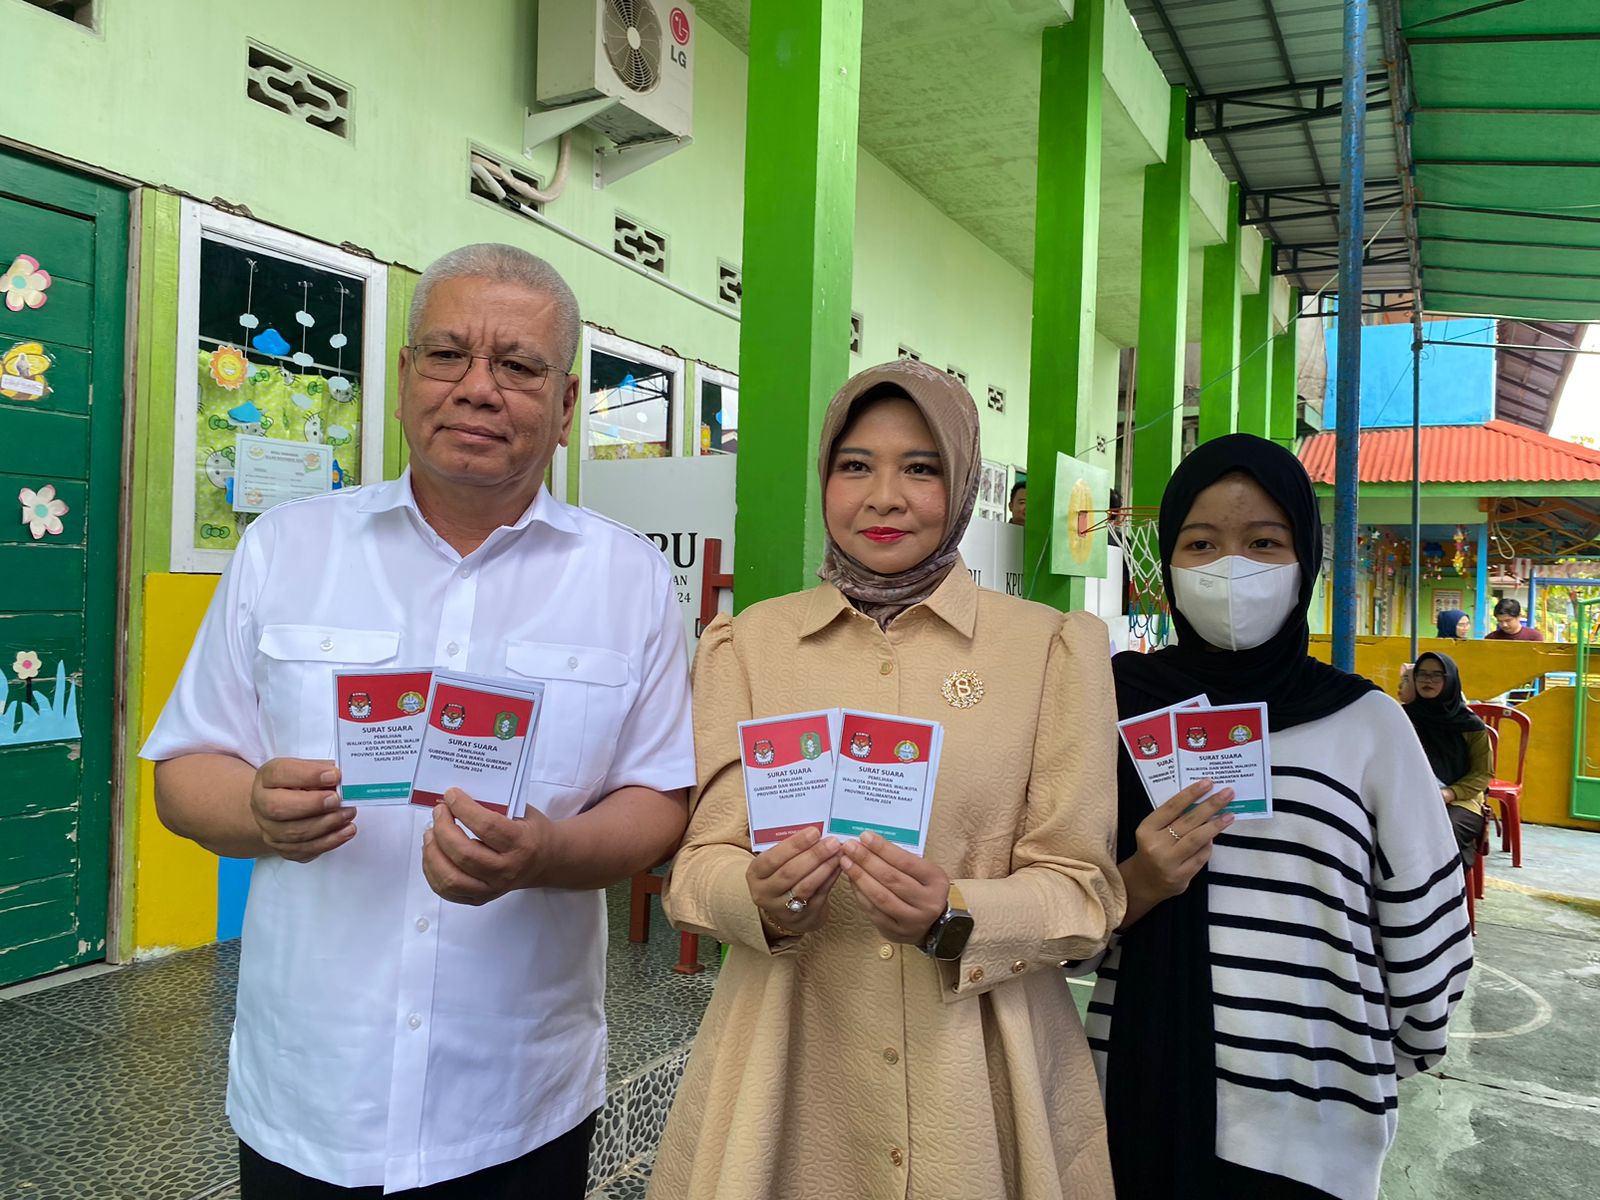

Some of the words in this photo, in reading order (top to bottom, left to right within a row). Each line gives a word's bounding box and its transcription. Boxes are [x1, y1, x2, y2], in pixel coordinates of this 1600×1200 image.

[671, 45, 687, 69] LG
[448, 738, 472, 748] SURAT
[473, 743, 498, 752] SUARA
[458, 748, 485, 756] PEMILIHAN
[428, 748, 455, 757] GUBERNUR
[486, 757, 512, 766] GUBERNUR
[430, 754, 455, 763] PROVINSI
[455, 759, 490, 768] KALIMANTAN
[1156, 758, 1174, 767] SURA
[767, 770, 787, 778] SURAT
[789, 767, 812, 775] SUARA
[858, 766, 880, 774] SURAT
[881, 769, 904, 778] SUARA
[868, 775, 893, 783] PEMILIHAN
[779, 786, 810, 794] KALIMANTAN
[872, 787, 900, 795] PONTIANAK
[894, 784, 918, 792] WALIKOTA
[864, 796, 879, 804] TAHUN
[866, 791, 897, 800] KALIMANTAN
